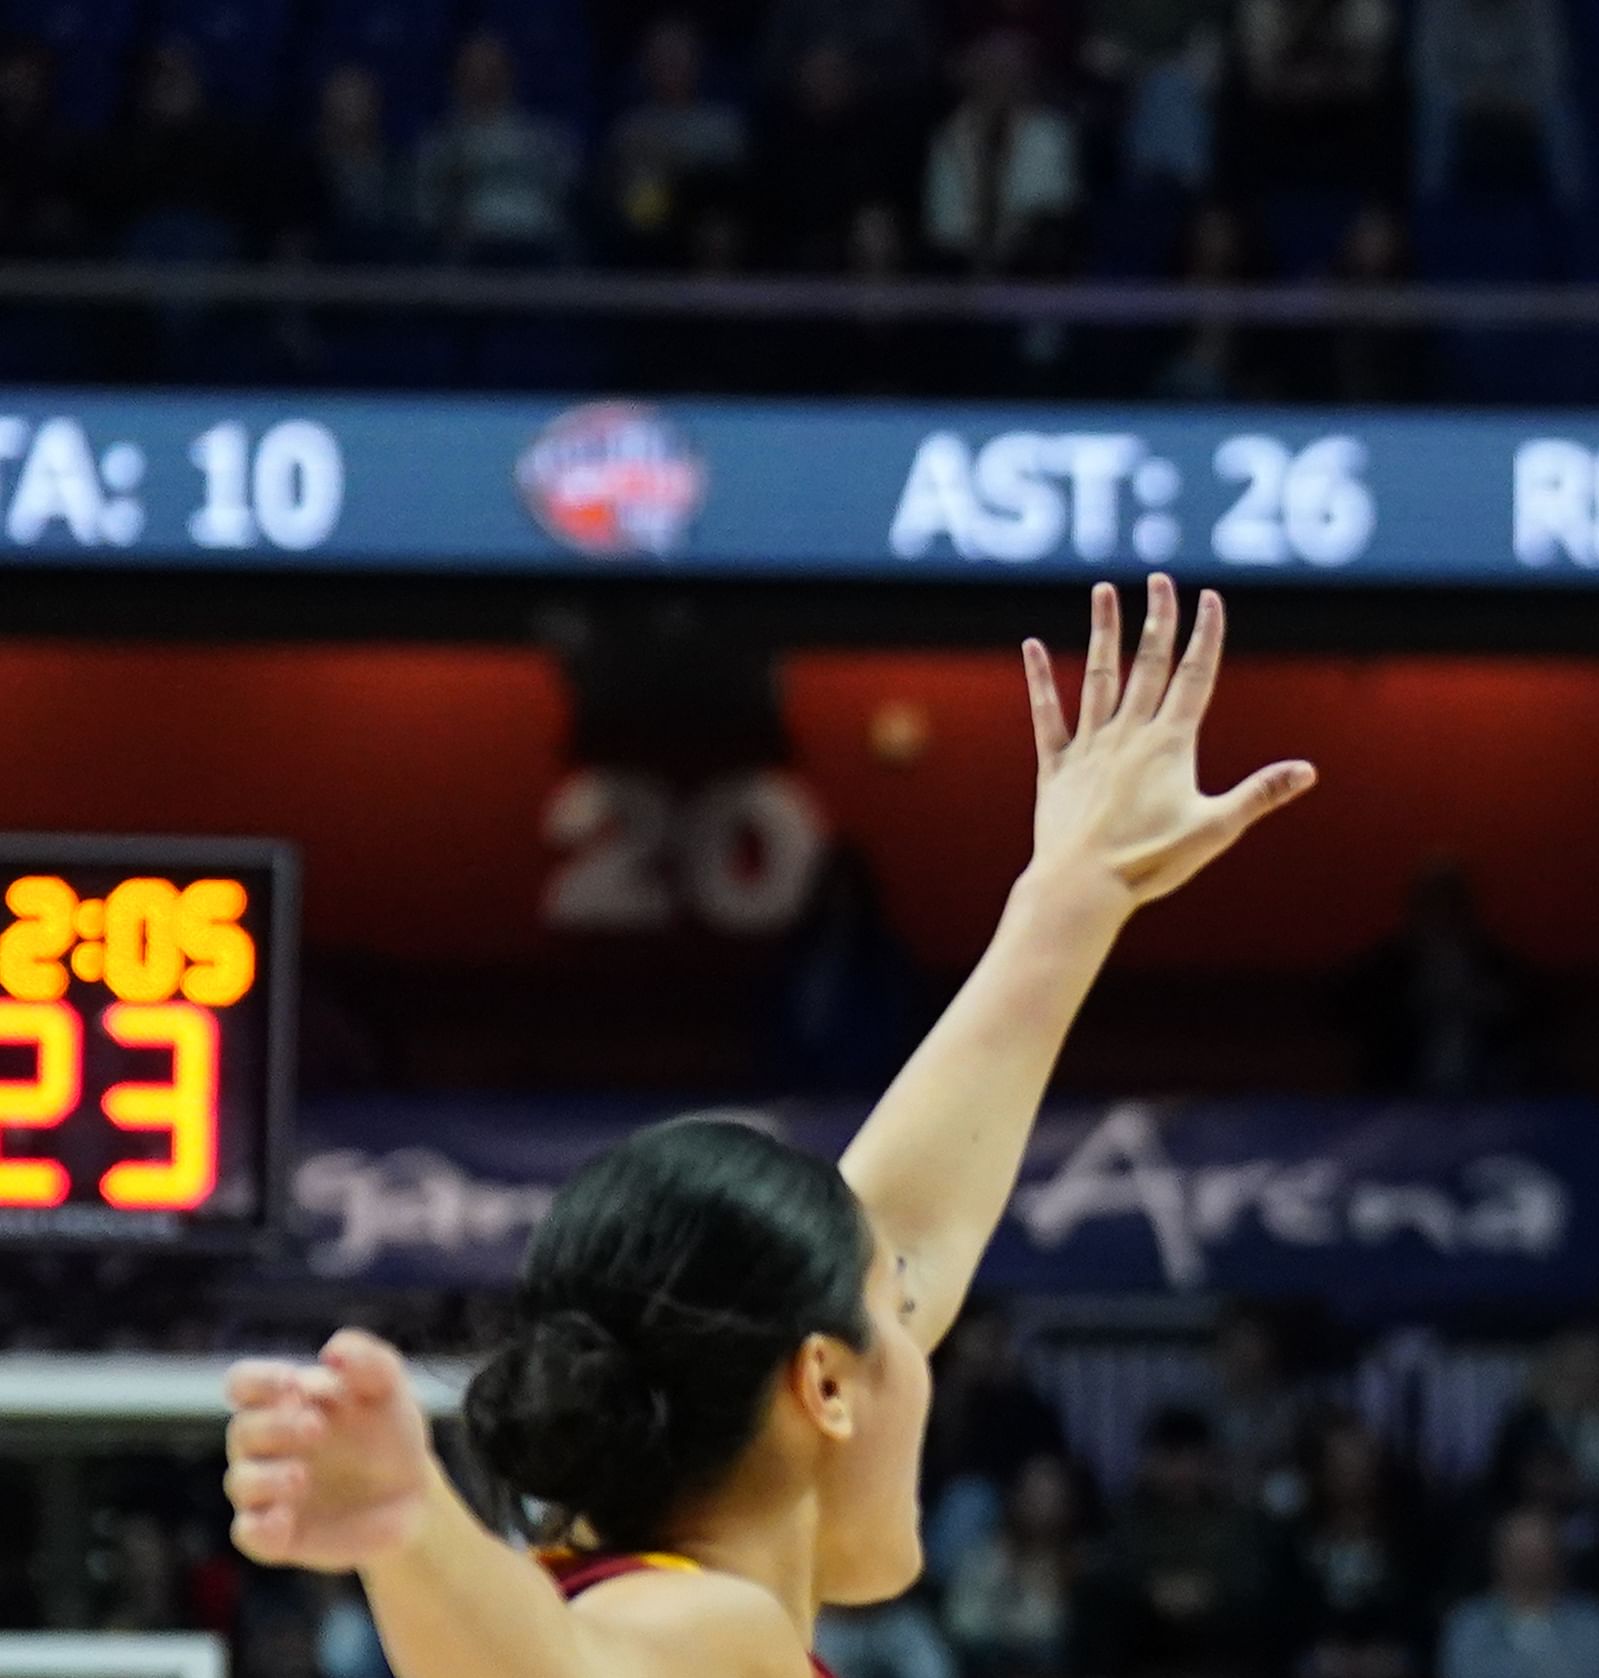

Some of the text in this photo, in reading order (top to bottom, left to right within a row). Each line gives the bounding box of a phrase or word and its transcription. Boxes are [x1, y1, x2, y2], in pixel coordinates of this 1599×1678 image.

[188, 418, 346, 551] 10
[889, 430, 1183, 566] AST:
[1210, 432, 1378, 568] 26
[544, 768, 832, 932] 20
[1018, 1103, 1570, 1291] Arena
